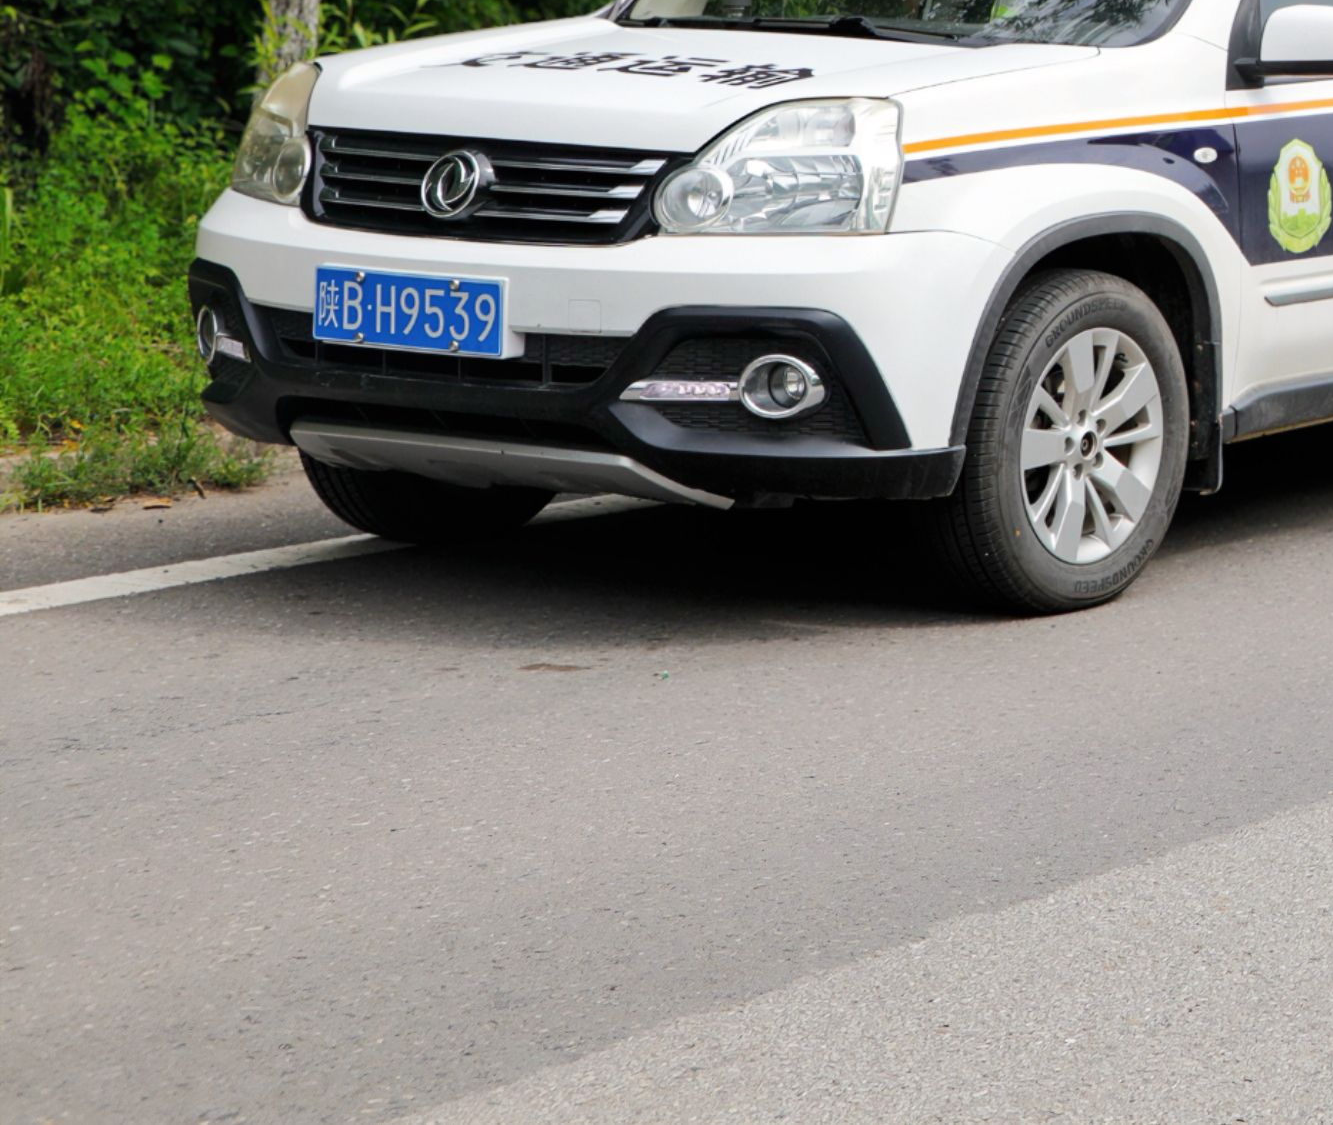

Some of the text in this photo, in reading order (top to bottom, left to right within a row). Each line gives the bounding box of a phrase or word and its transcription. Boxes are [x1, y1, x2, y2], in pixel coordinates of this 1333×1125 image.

[421, 51, 815, 89] 交通运输
[318, 279, 496, 342] 陕B·H9539
[1045, 297, 1127, 349] GROUNDSPEED
[1074, 538, 1154, 594] GROUNDSPEED
